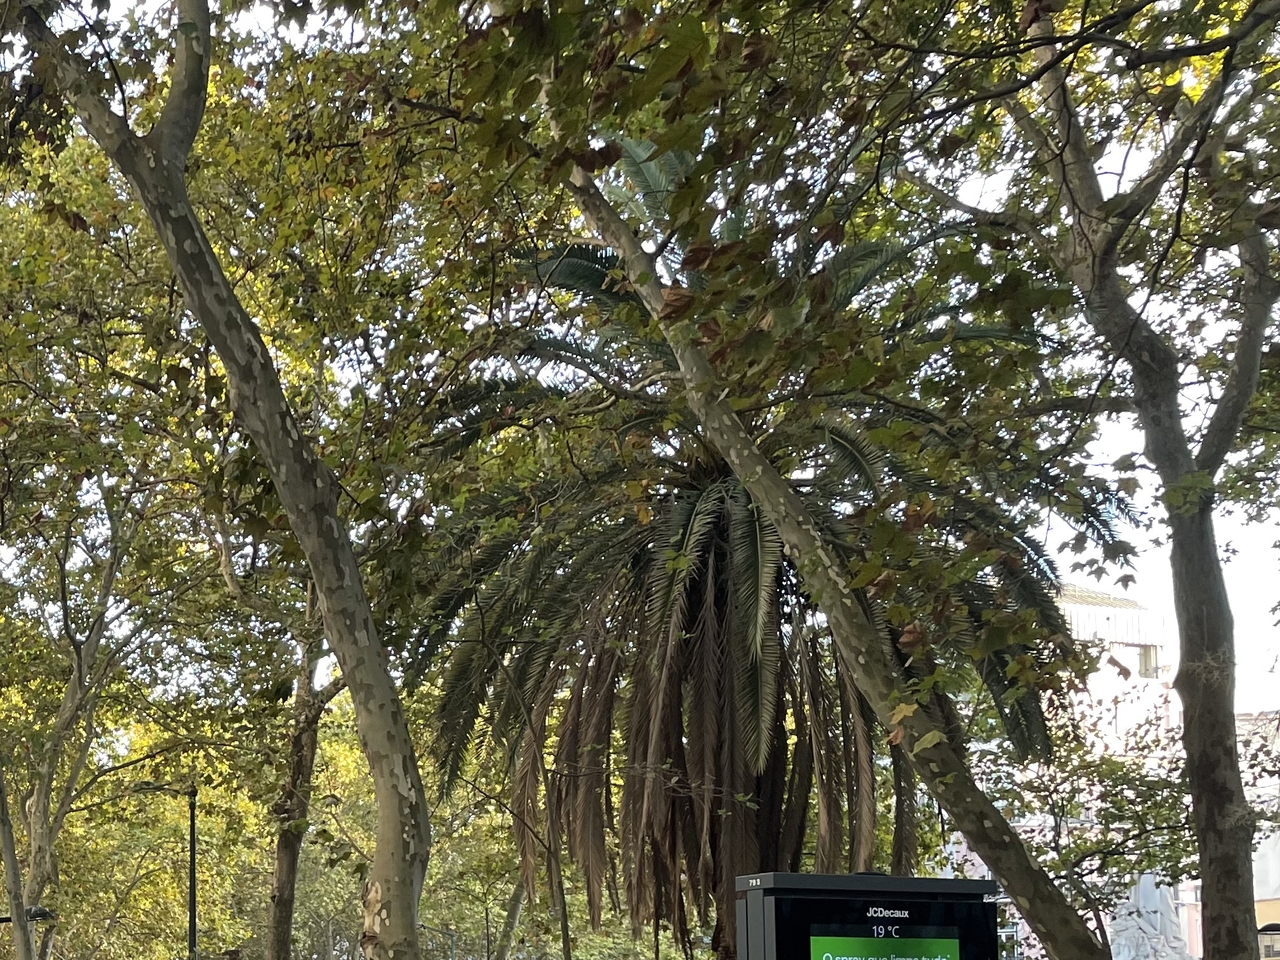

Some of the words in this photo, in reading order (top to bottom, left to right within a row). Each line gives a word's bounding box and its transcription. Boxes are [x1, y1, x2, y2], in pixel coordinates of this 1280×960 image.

[866, 906, 909, 918] JCDecaux
[872, 925, 885, 938] 19
[887, 925, 900, 938] °C
